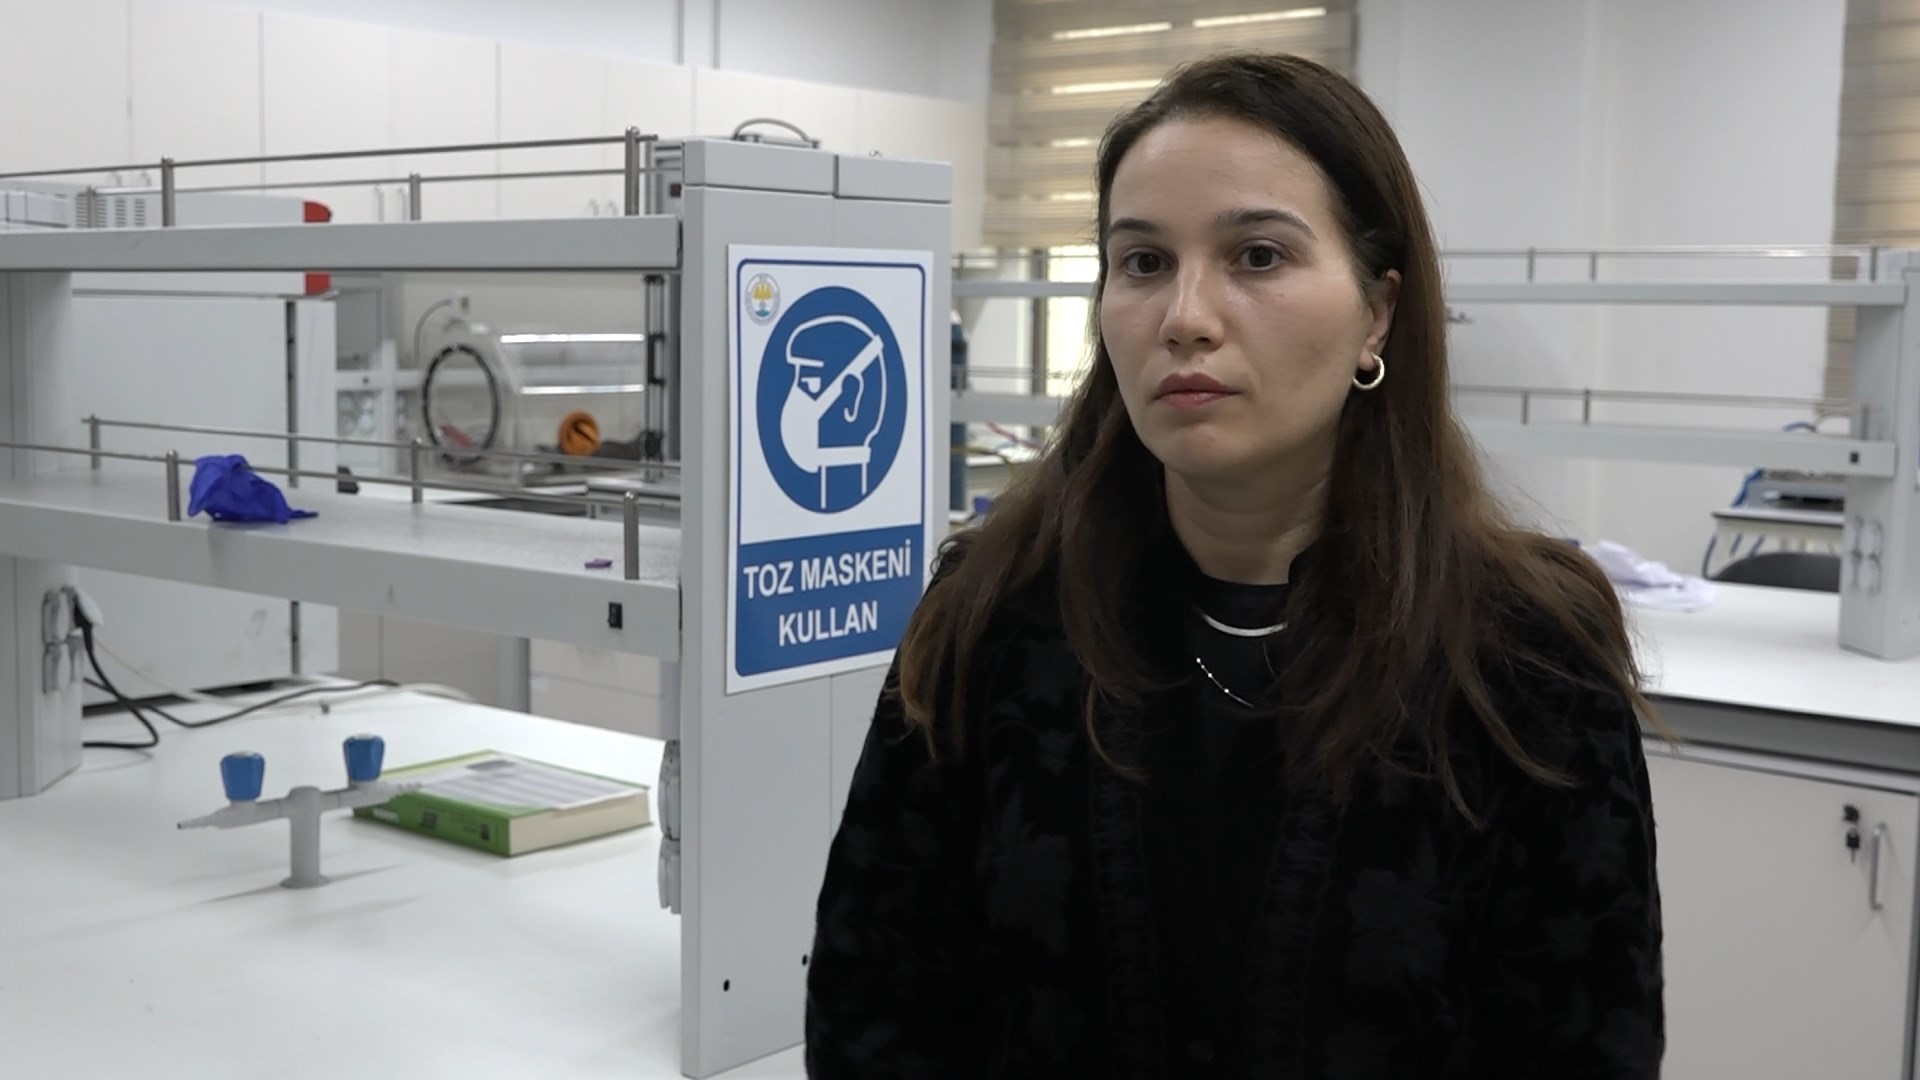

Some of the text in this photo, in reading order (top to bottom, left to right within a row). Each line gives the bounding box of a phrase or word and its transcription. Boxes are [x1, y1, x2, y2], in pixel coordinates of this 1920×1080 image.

[743, 539, 912, 599] TOZ MASKENİ
[779, 600, 878, 647] KULLAN
